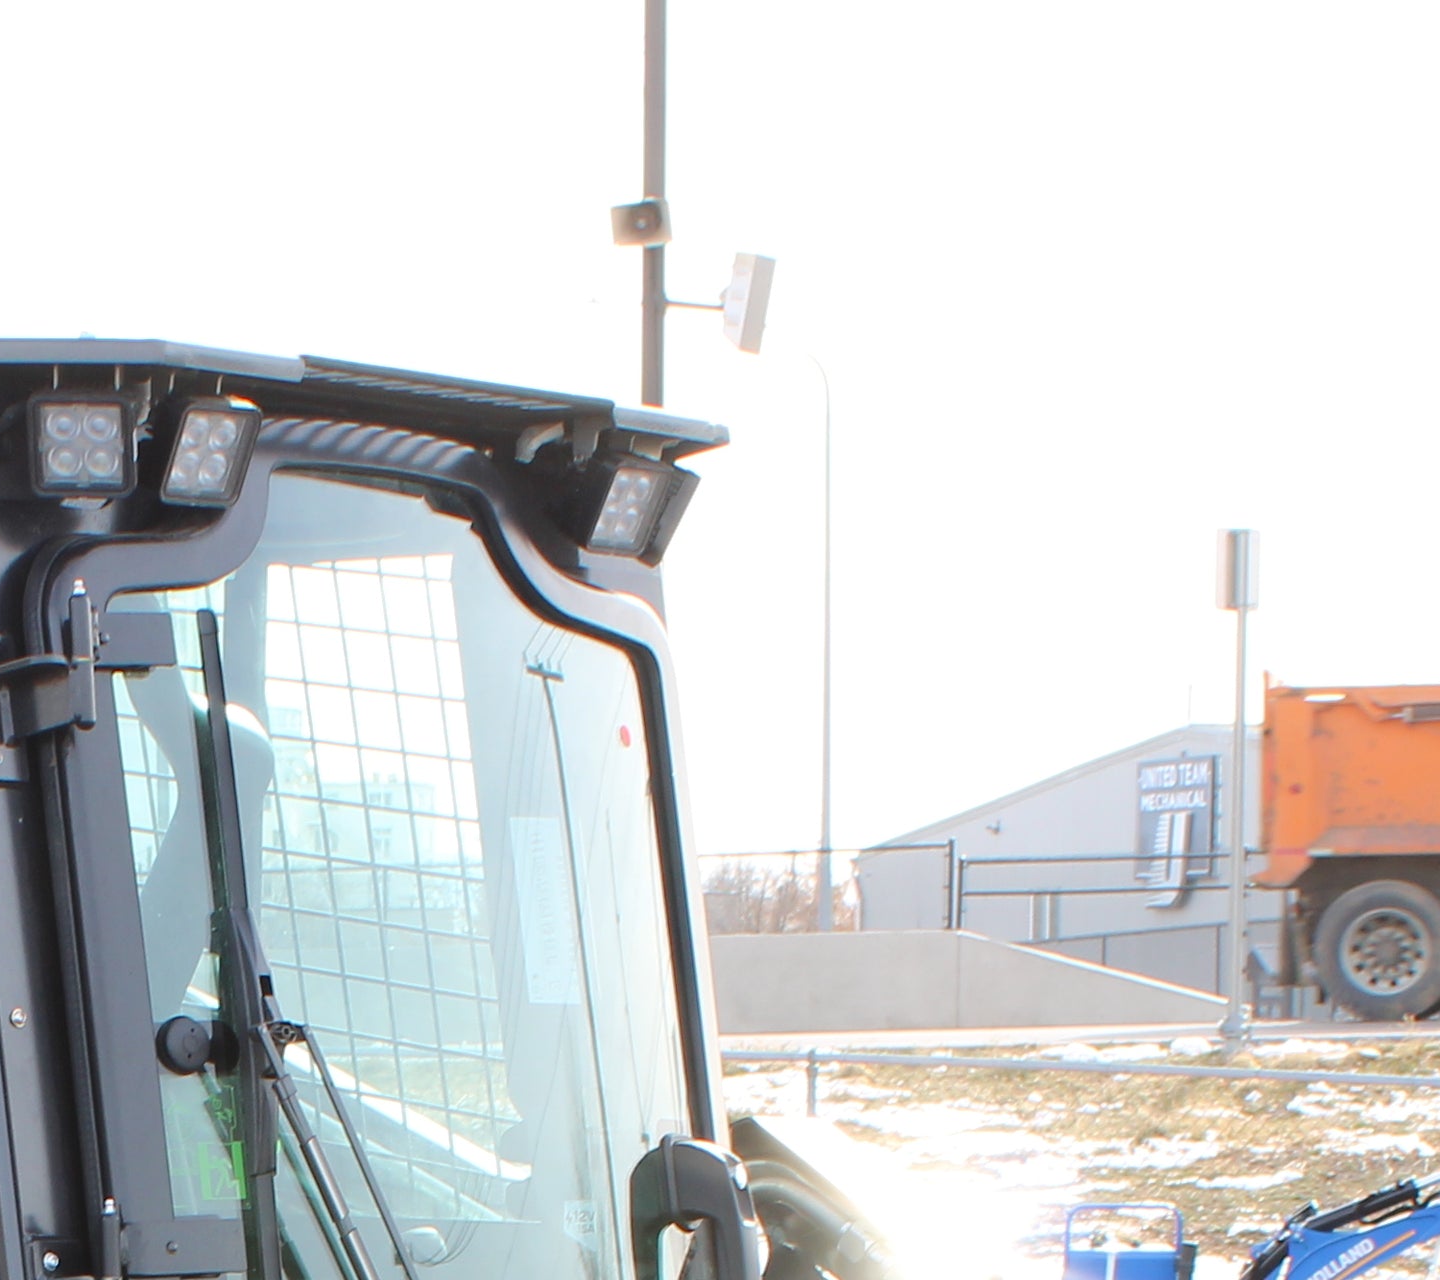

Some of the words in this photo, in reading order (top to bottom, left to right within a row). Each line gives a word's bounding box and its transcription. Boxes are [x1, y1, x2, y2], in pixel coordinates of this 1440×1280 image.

[1140, 764, 1177, 790] UNITED
[1178, 761, 1209, 786] TEAM
[1140, 789, 1207, 812] MECHANICAL
